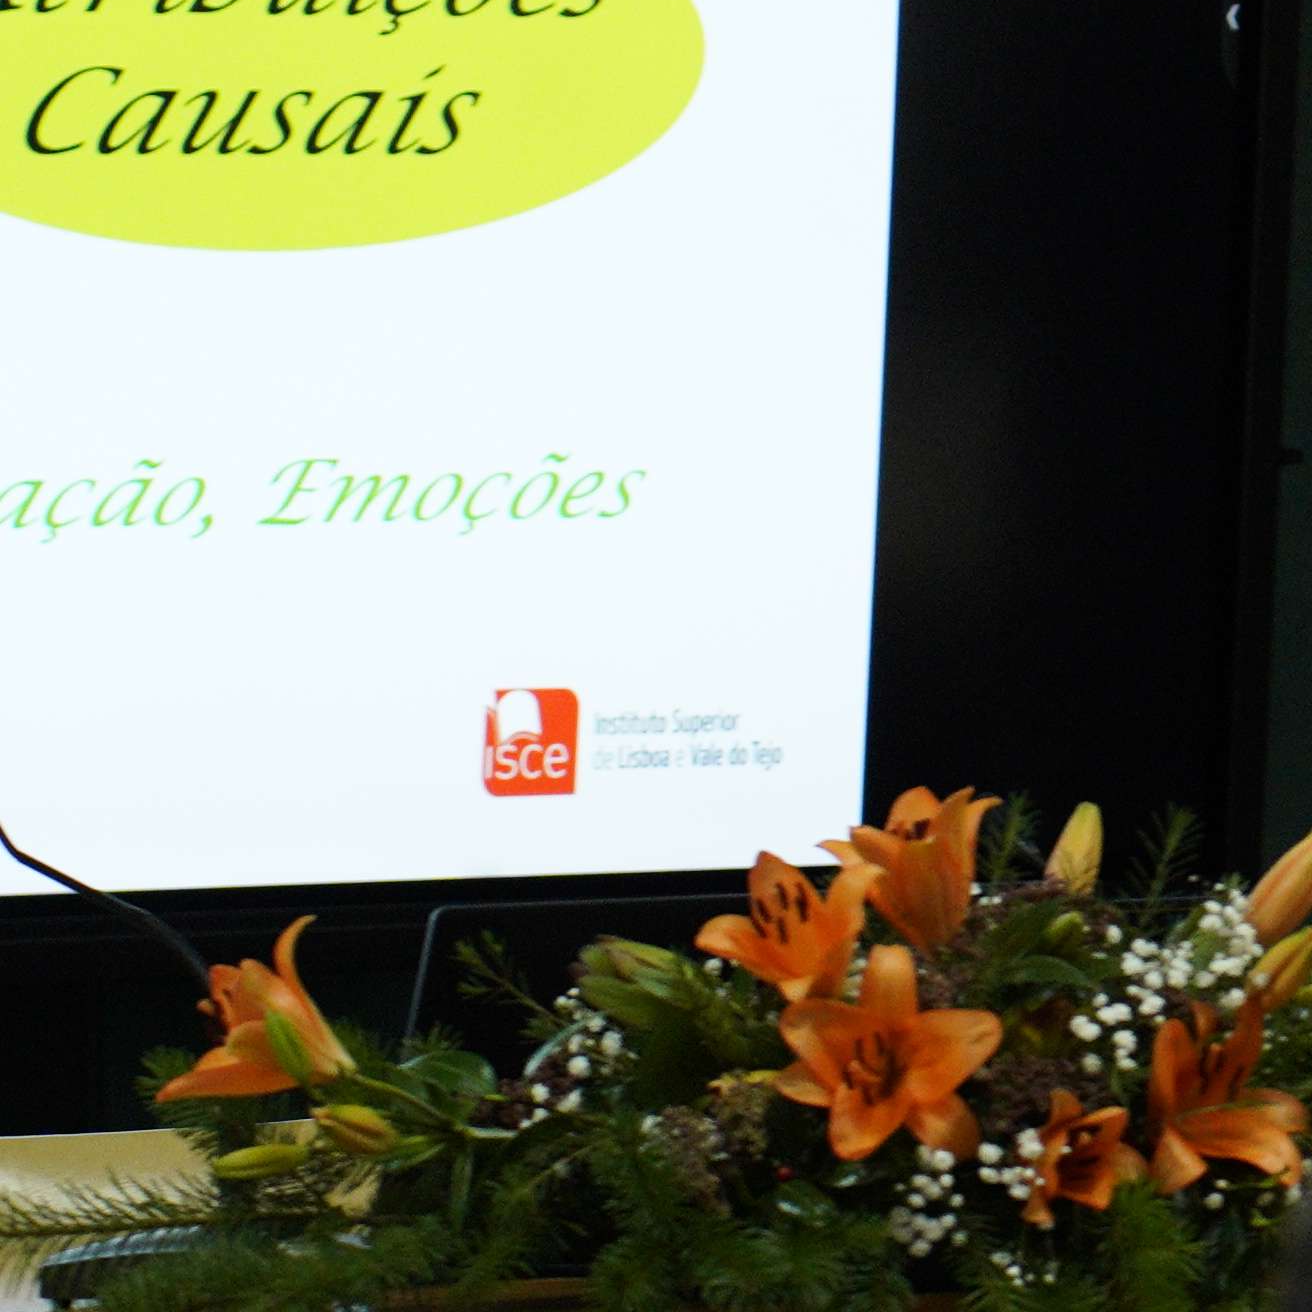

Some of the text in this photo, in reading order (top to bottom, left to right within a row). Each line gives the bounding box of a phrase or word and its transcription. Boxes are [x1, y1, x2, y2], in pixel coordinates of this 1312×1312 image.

[24, 65, 482, 156] Causais
[257, 451, 648, 536] Emoções
[594, 708, 741, 737] Instituto Superior
[618, 745, 671, 769] Lisboa
[690, 743, 724, 767] Vale
[728, 742, 748, 766] do
[751, 740, 784, 771] Tejo
